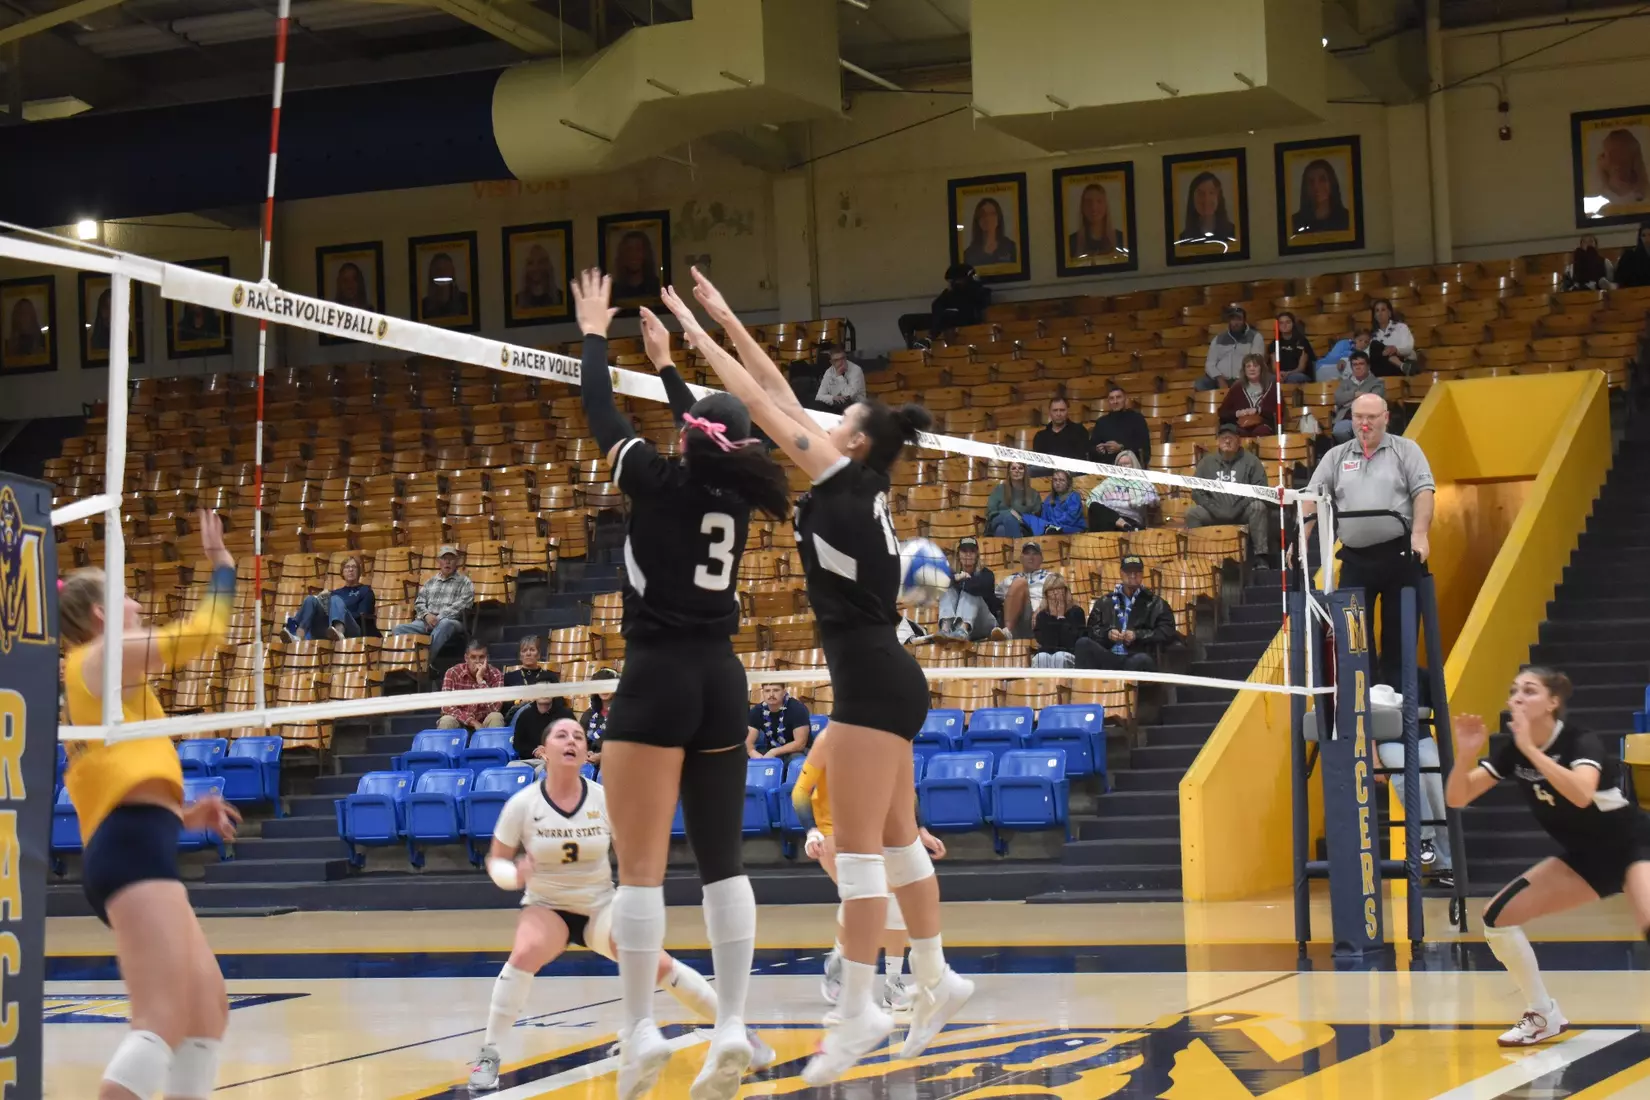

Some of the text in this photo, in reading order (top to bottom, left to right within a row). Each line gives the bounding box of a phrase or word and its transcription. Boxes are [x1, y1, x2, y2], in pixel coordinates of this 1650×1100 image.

[247, 289, 374, 335] RACER VOLLEYBALL
[512, 350, 582, 378] RACER VOLLE
[693, 512, 736, 591] 3
[1354, 669, 1377, 940] RACERS
[536, 825, 602, 839] MURRAY STATE
[561, 841, 579, 864] 3
[0, 688, 27, 1100] RAC
